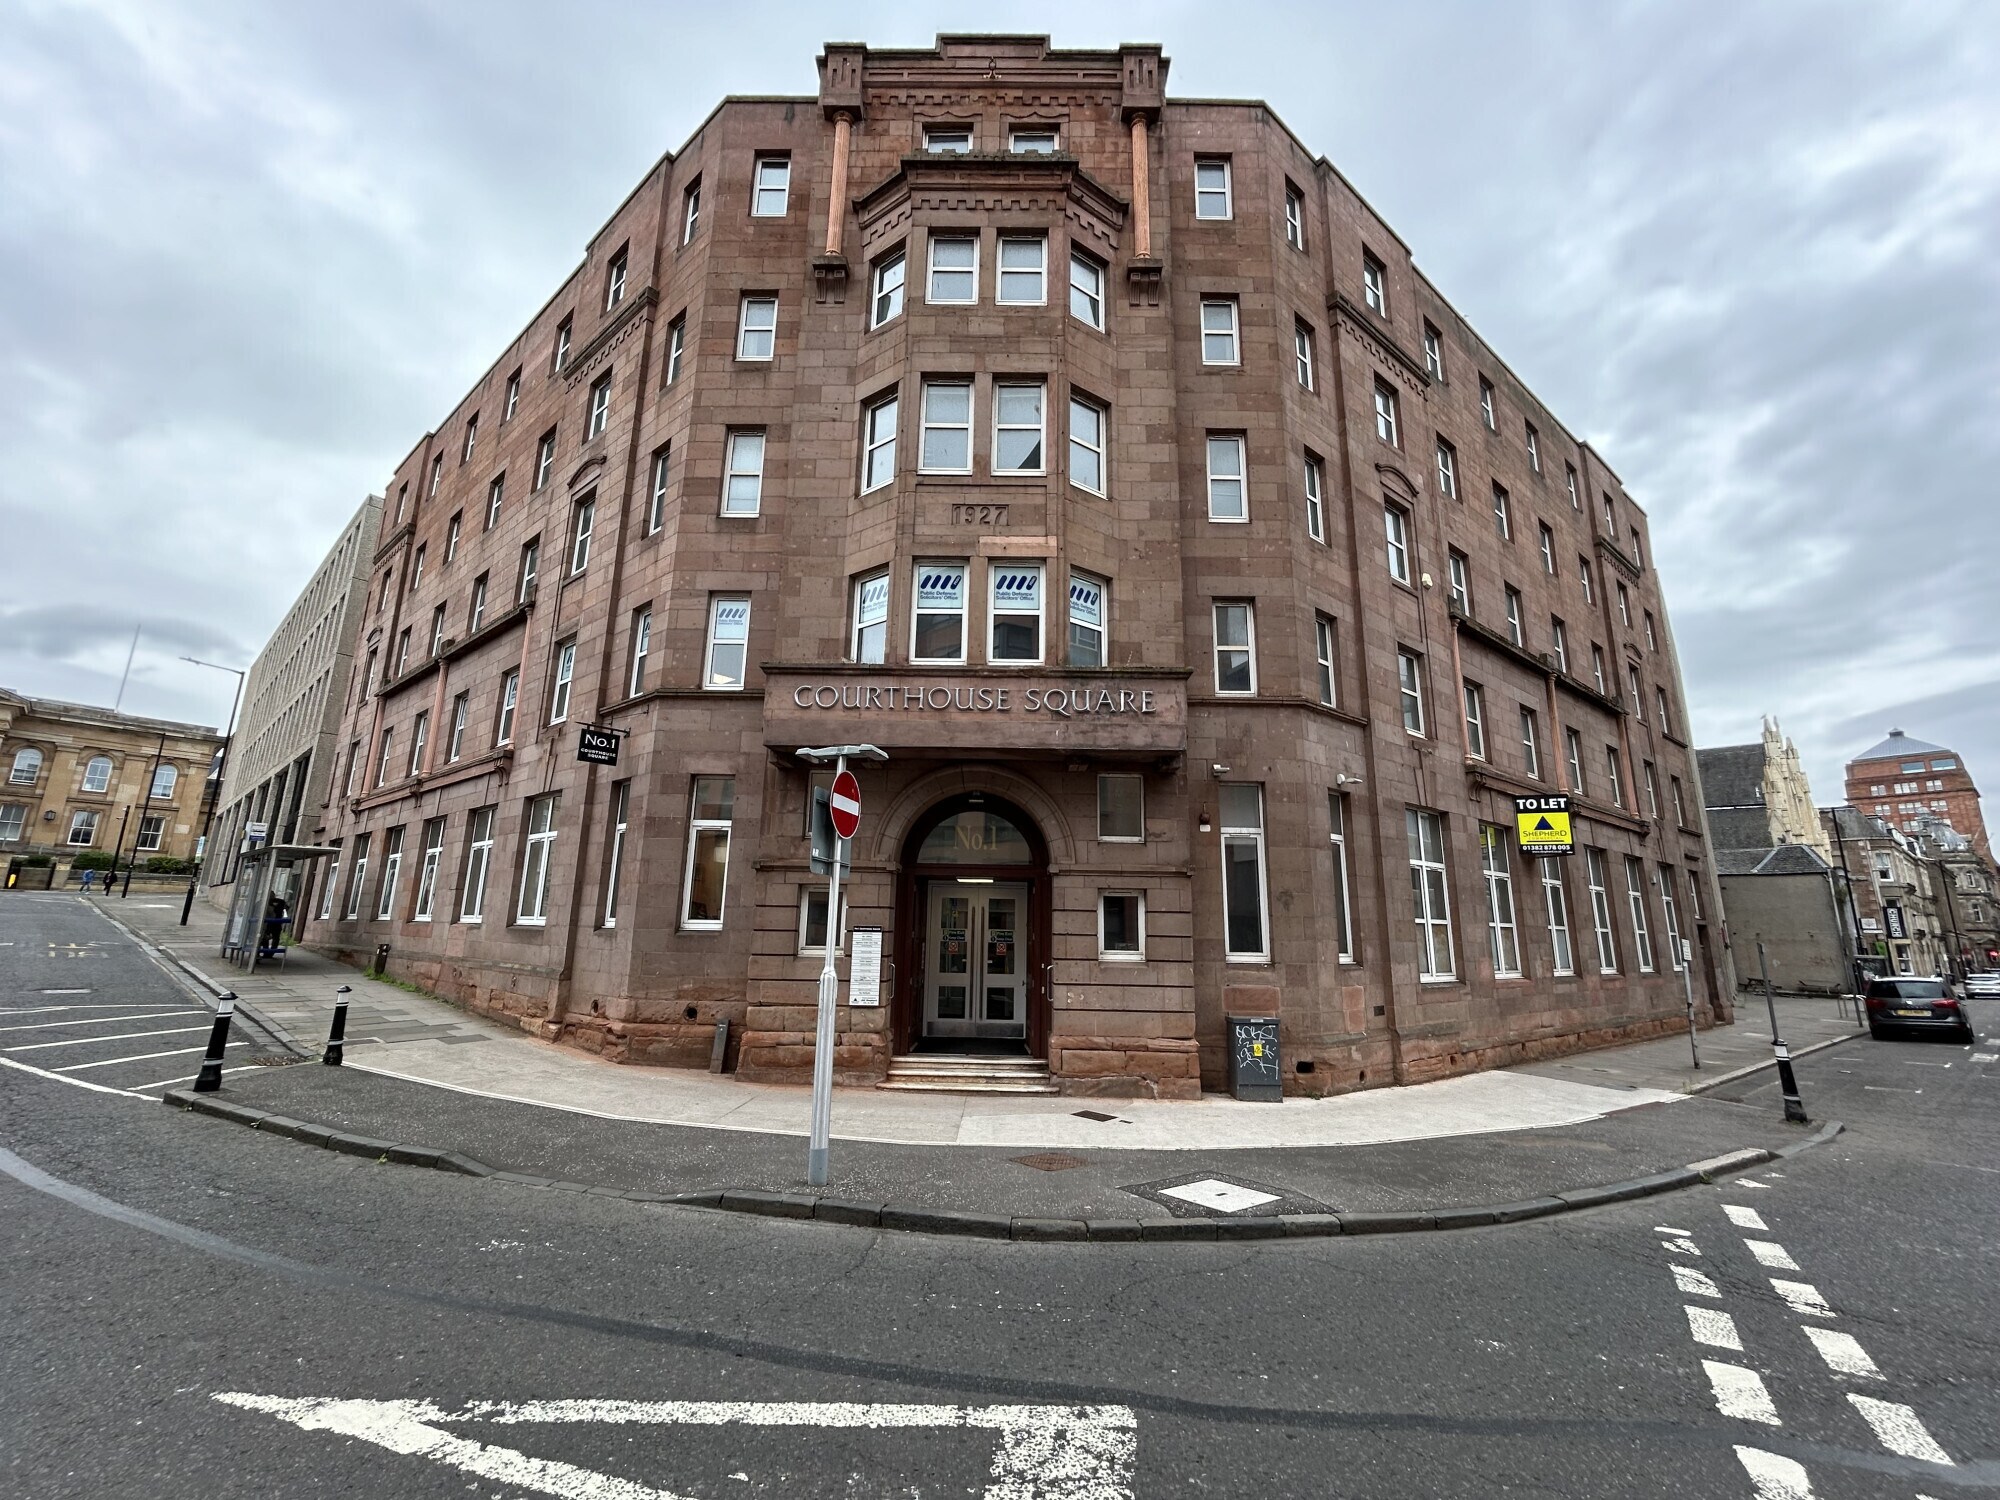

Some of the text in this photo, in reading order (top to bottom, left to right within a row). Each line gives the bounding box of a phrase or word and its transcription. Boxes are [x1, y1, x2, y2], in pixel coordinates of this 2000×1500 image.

[954, 506, 1006, 525] 1927
[794, 685, 1158, 716] COURTHOUSE SQUARE
[580, 748, 617, 757] COURTHOUSE
[1516, 797, 1567, 810] TO LET
[1888, 908, 1902, 937] CHURCH
